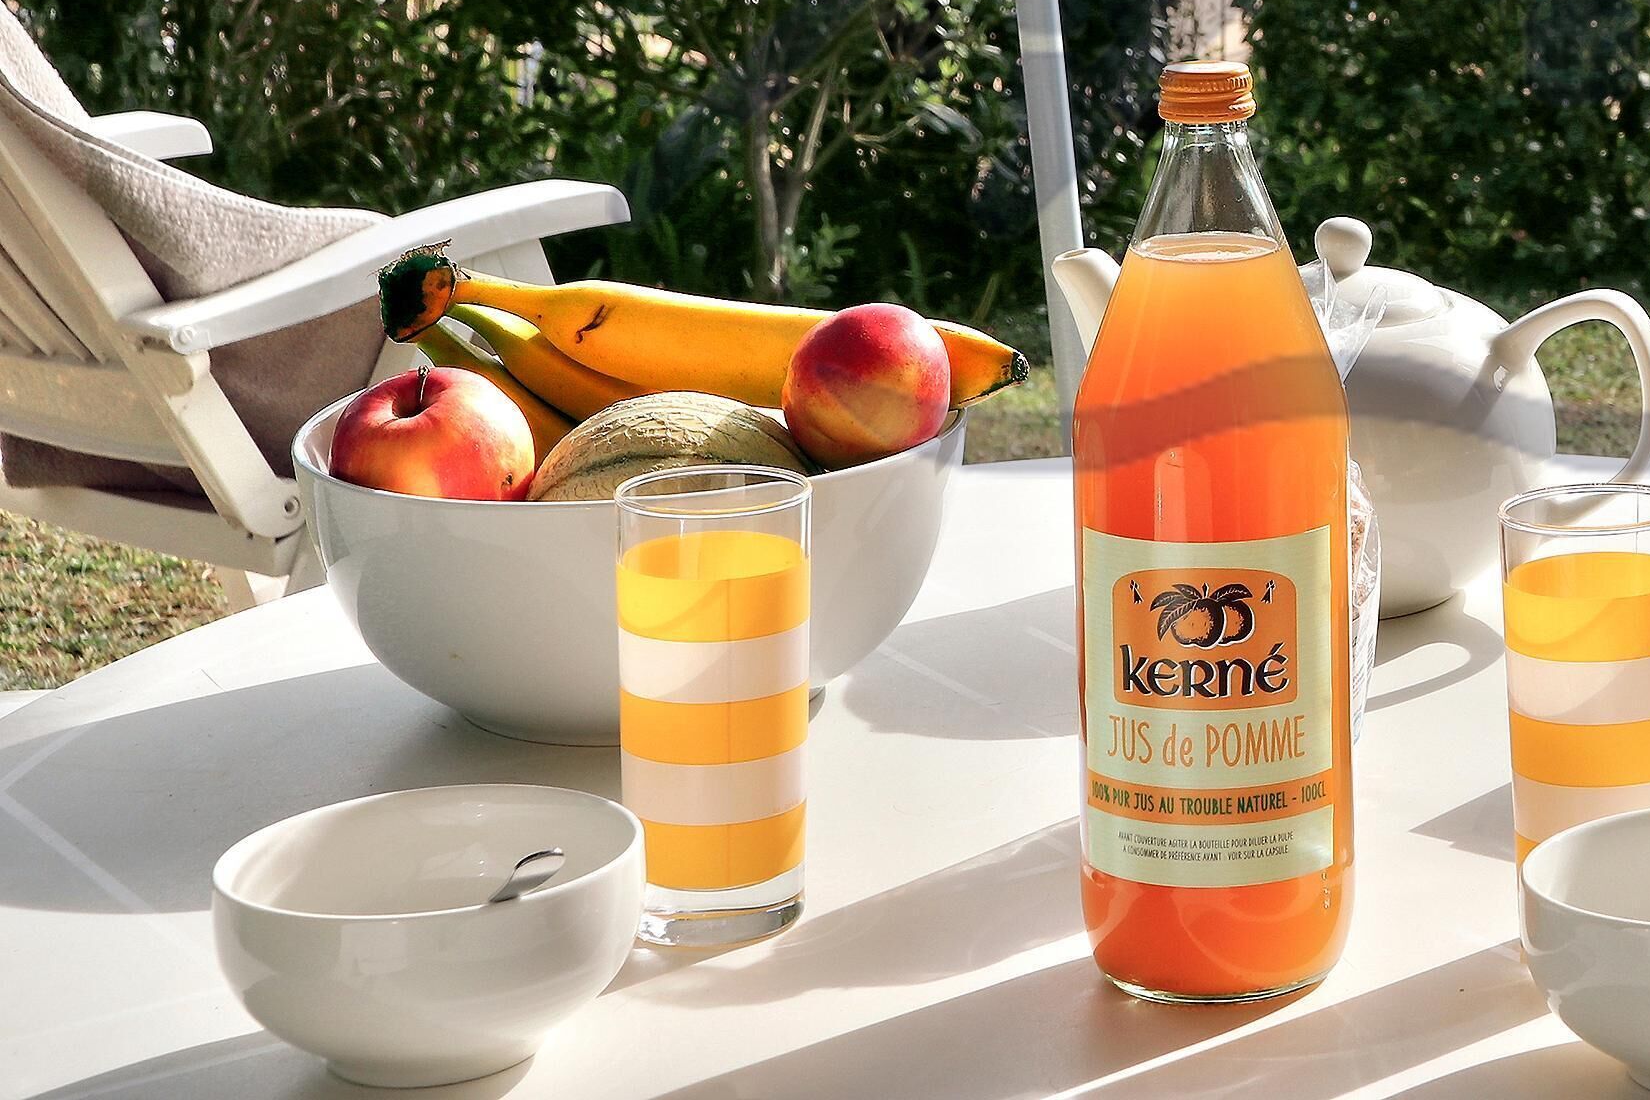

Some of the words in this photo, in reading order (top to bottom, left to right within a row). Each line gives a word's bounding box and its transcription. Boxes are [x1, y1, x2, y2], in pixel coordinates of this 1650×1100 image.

[1107, 715, 1153, 764] JUS
[1162, 723, 1194, 768] de
[1206, 714, 1305, 768] POMME
[1091, 780, 1110, 803] 100%
[1112, 787, 1131, 808] PUR
[1133, 792, 1155, 812] JUS
[1159, 796, 1175, 814] AU
[1179, 797, 1233, 816] TROUBLE
[1237, 791, 1288, 814] NATUREL
[1301, 780, 1327, 804] 100CL
[1160, 850, 1167, 860] DE
[1228, 851, 1242, 861] VOIR
[1243, 849, 1255, 860] SUR
[1256, 848, 1264, 859] LA
[1265, 844, 1288, 857] CAPSULE
[1190, 839, 1197, 849] LA
[1199, 839, 1230, 849] BOUTEILLE
[1231, 838, 1247, 848] POUR
[1270, 834, 1276, 844] LA
